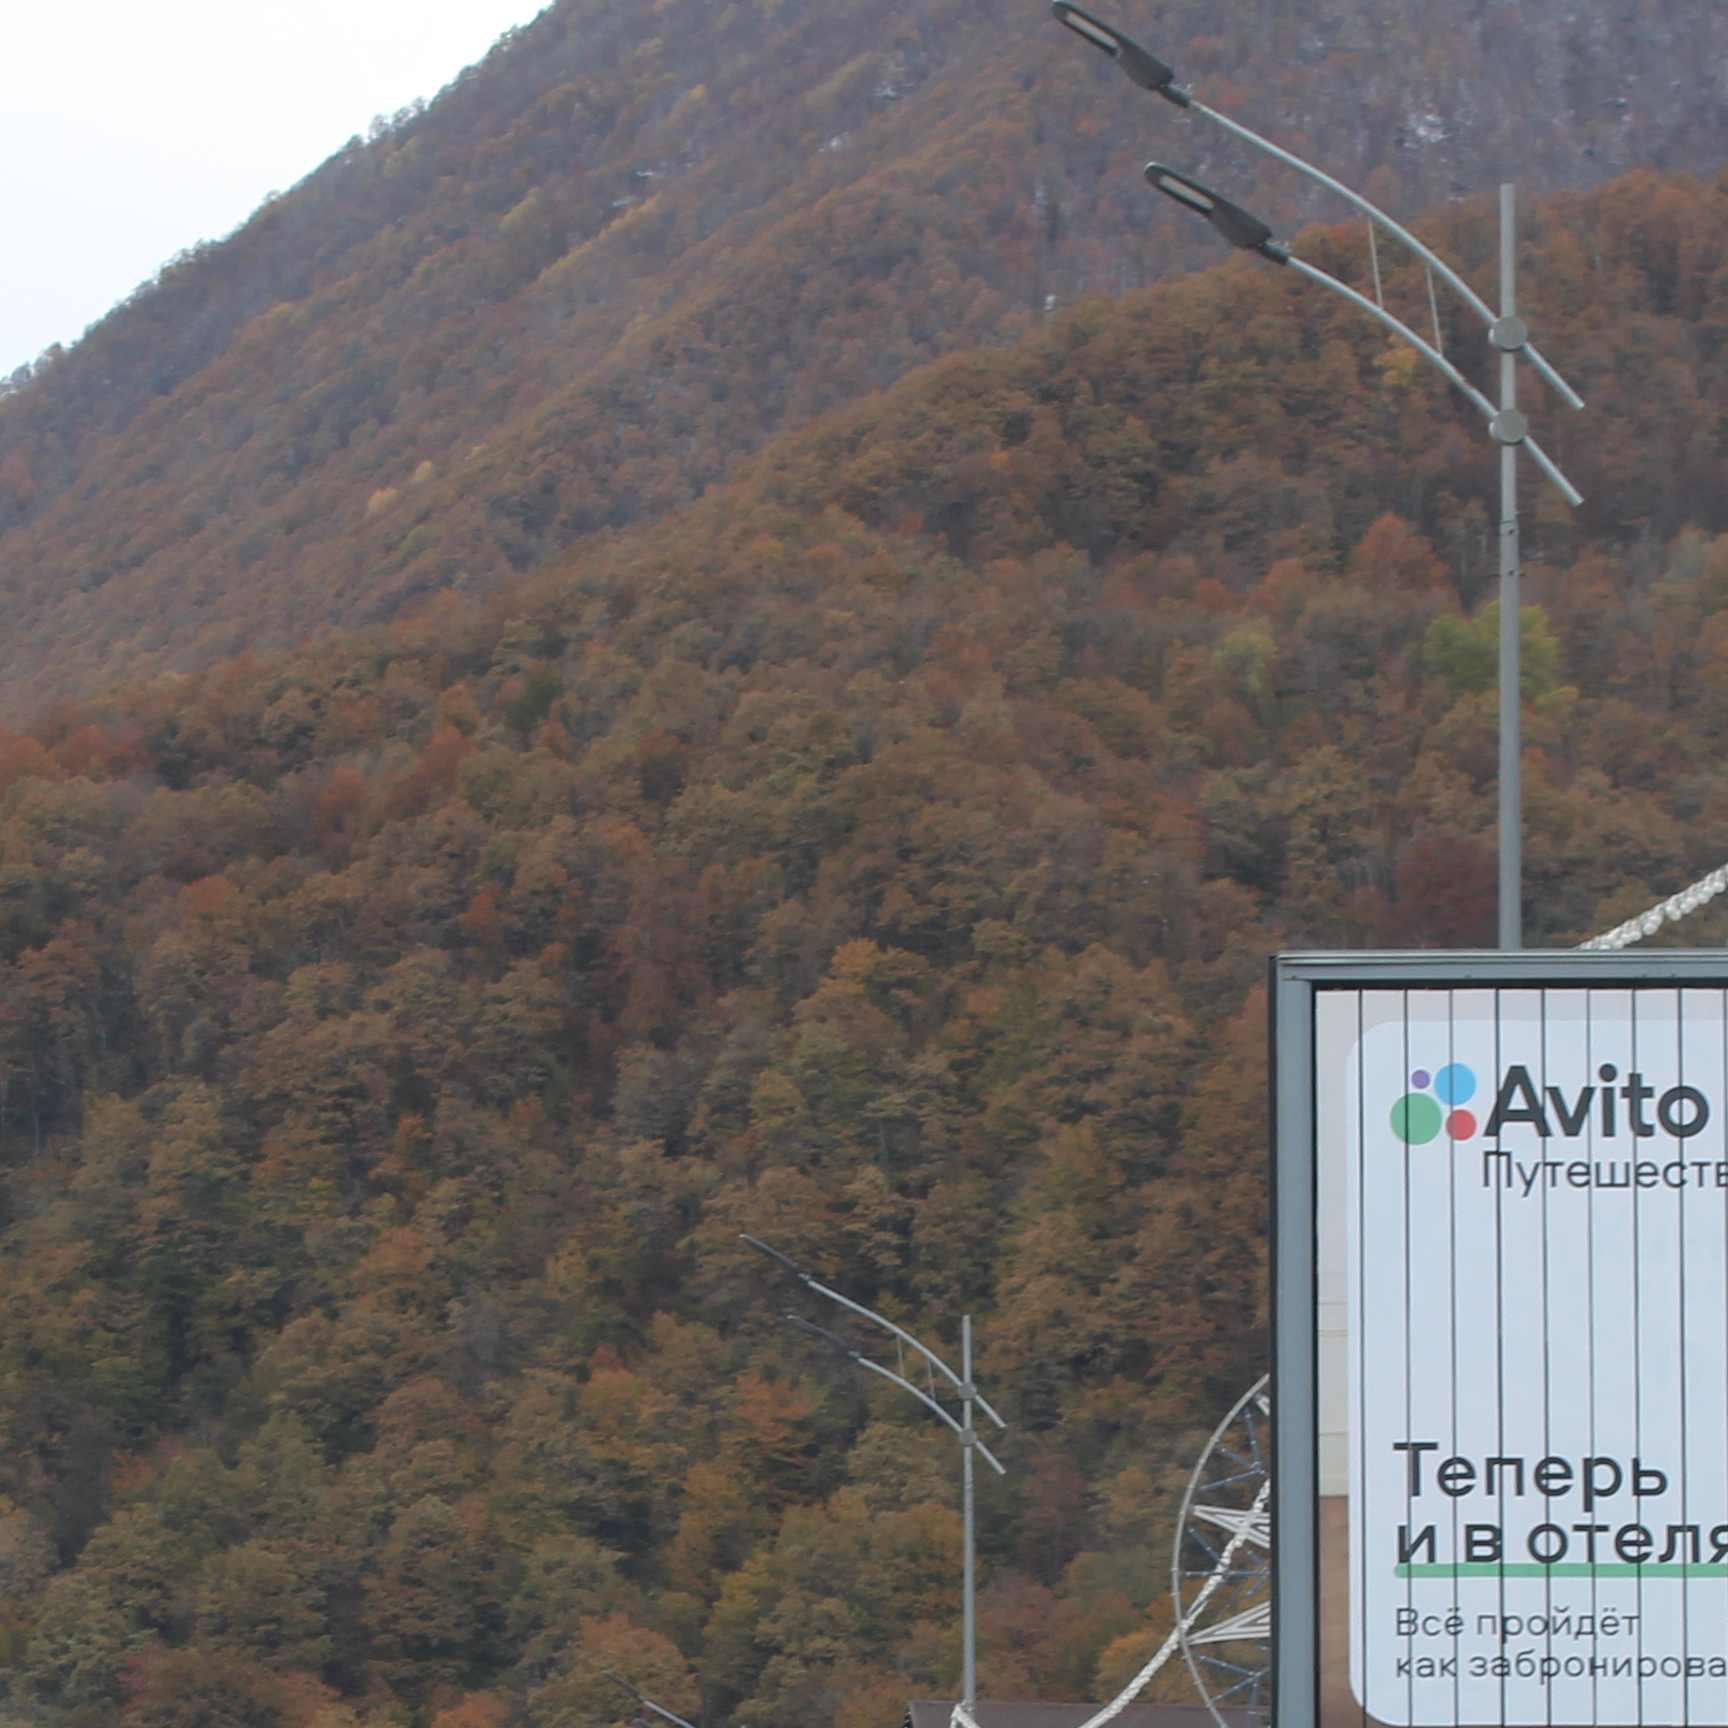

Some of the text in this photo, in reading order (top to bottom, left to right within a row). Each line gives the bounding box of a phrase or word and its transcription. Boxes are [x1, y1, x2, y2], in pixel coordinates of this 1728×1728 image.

[1482, 1062, 1711, 1139] Avito
[1393, 1442, 1669, 1513] Теперь
[1397, 1523, 1437, 1564] и
[1464, 1523, 1503, 1564] в
[1395, 1606, 1641, 1644] Всё пройдёт
[1395, 1655, 1457, 1678] как
